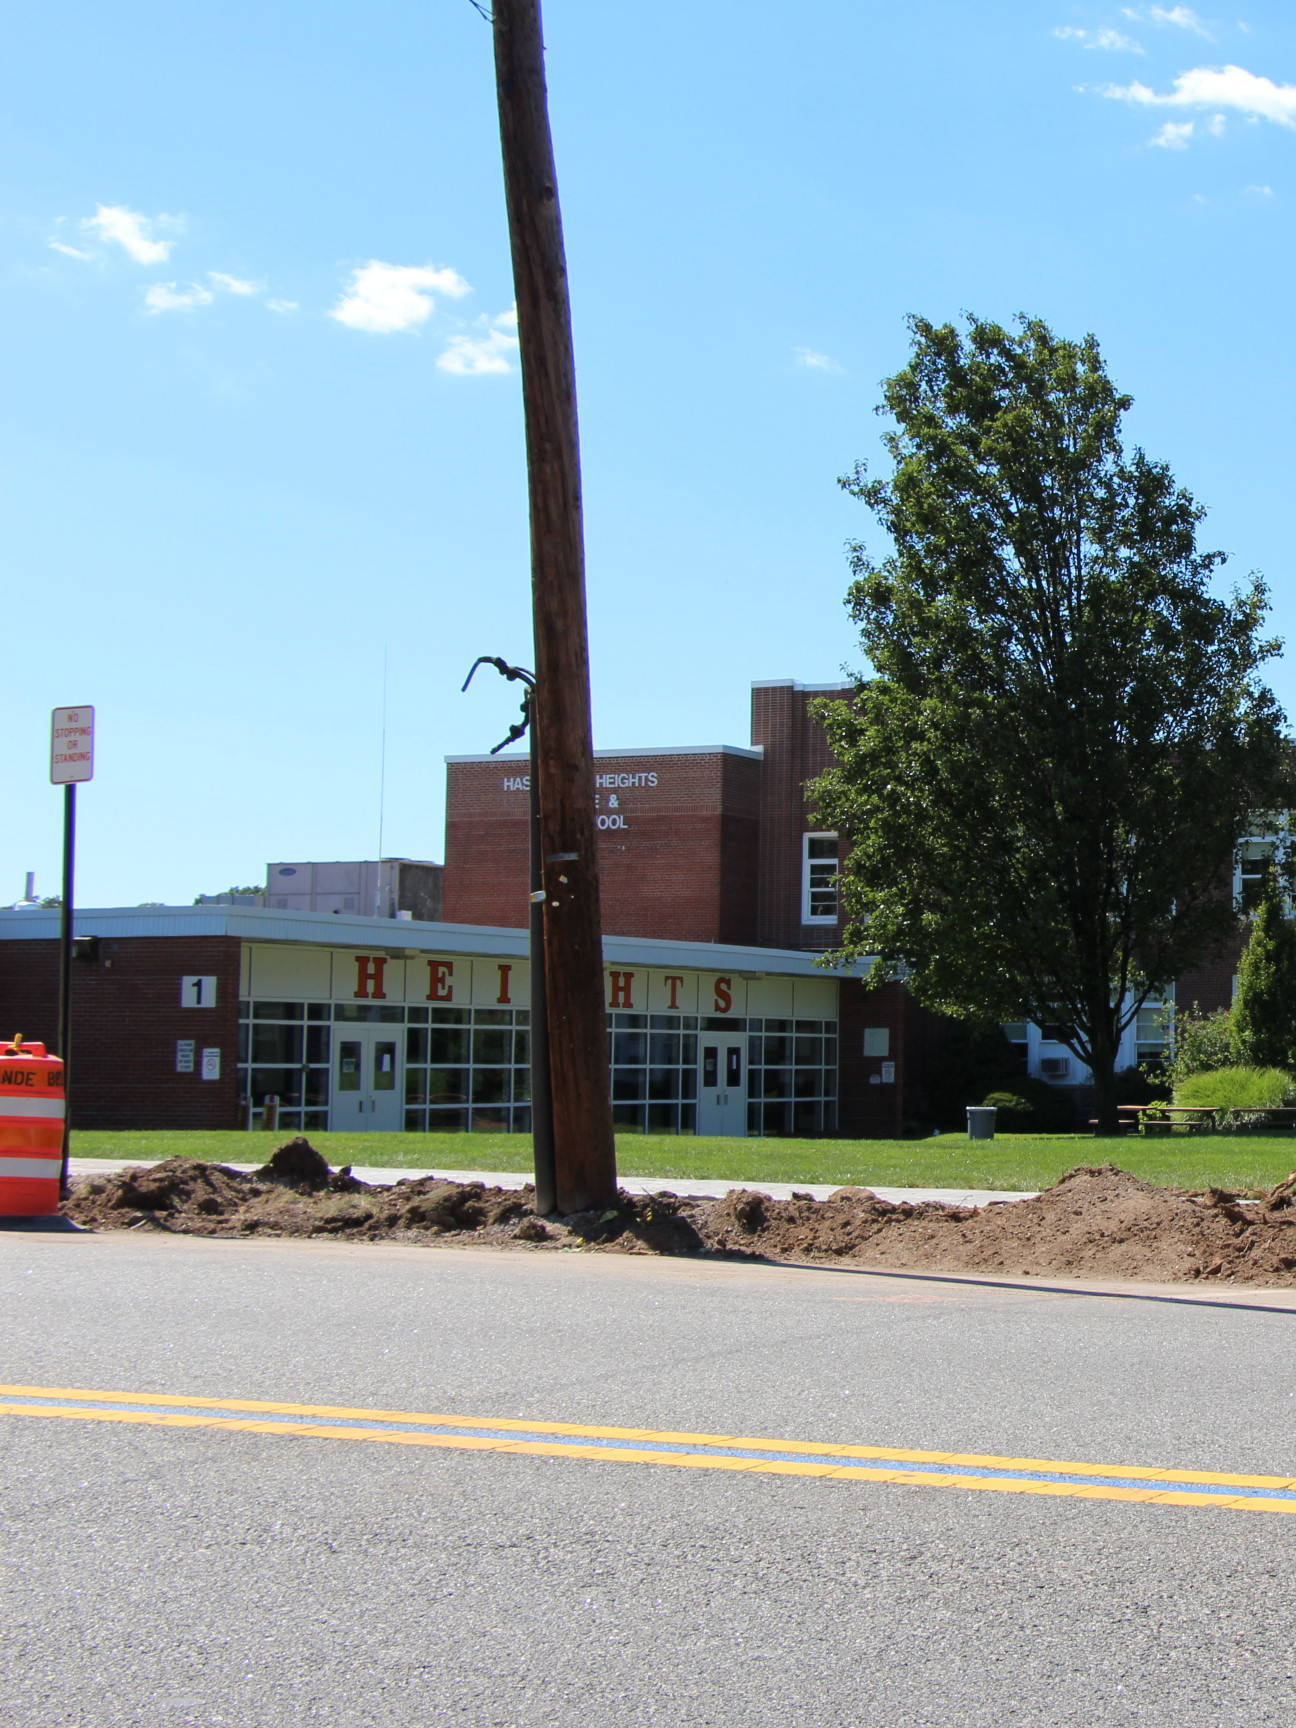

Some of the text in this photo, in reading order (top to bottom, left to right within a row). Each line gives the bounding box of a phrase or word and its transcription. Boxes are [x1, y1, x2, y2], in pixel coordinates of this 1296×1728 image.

[596, 772, 658, 788] HEIGHTS
[608, 794, 619, 808] &
[596, 815, 629, 829] OOL
[192, 978, 202, 1005] 1
[353, 955, 732, 1014] HEIHTS
[1, 1069, 36, 1087] NDE
